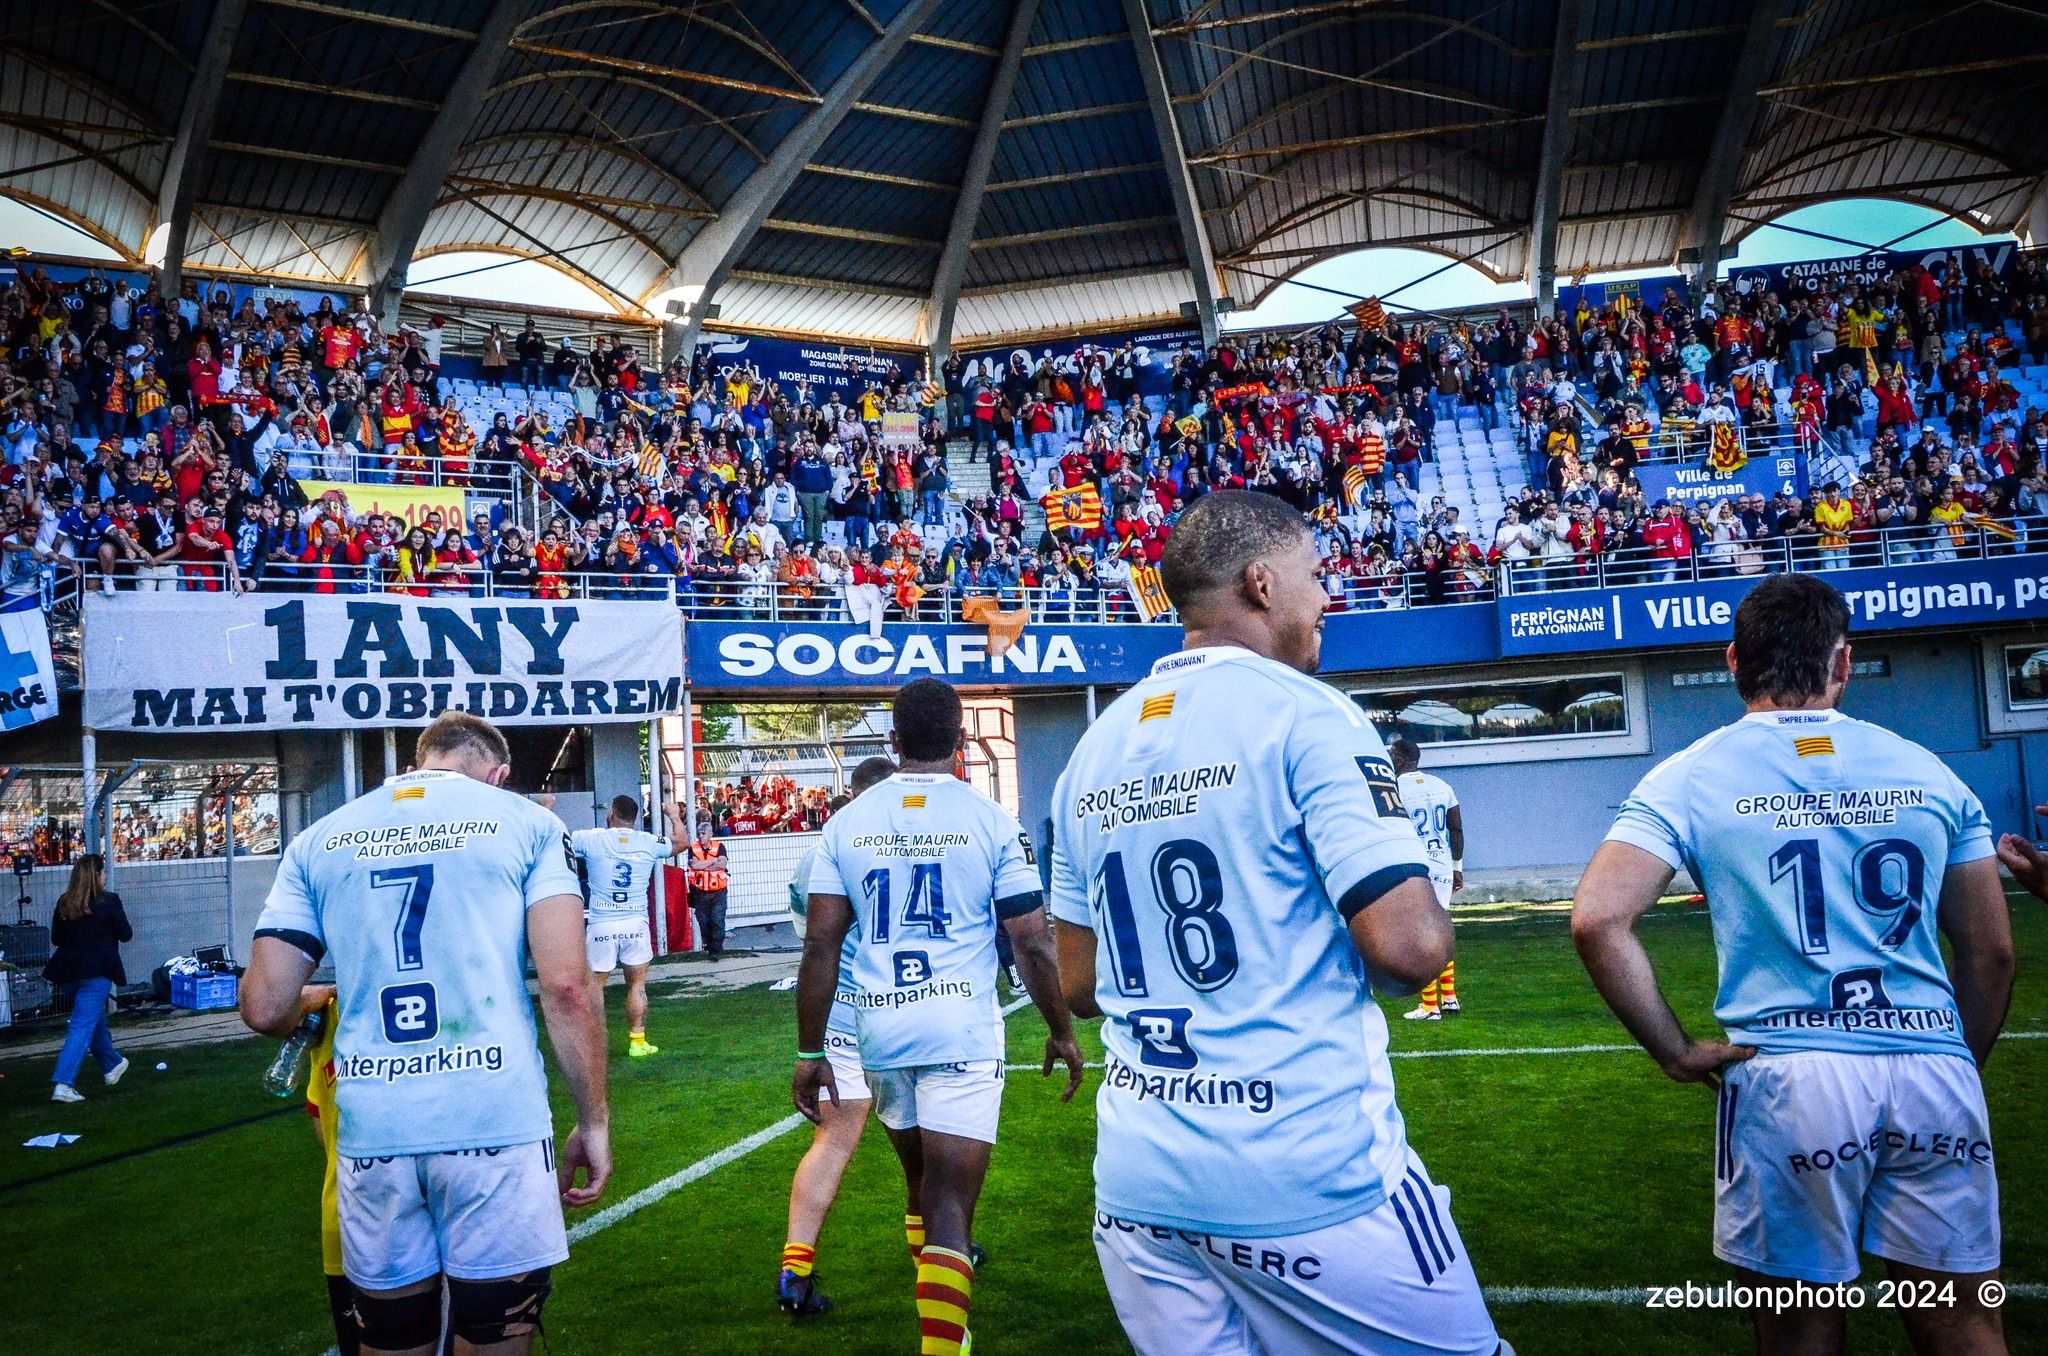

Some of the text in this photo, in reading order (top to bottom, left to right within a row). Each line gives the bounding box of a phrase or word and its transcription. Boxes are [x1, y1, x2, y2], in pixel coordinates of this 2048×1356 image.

[1782, 257, 1886, 278] CATALANE de
[257, 290, 291, 301] USAP
[1608, 282, 1637, 292] USAP
[801, 350, 841, 362] MAGASIN
[810, 360, 826, 368] ZONE
[1755, 363, 1766, 374] 15
[1218, 384, 1258, 398] USAP
[1676, 470, 1710, 483] Ville
[1666, 483, 1745, 501] Perpignan
[1783, 480, 1794, 495] 6
[1645, 596, 1731, 629] Ville
[1844, 582, 2005, 621] rpignan,
[264, 599, 580, 680] 1 ANY
[1511, 621, 1605, 637] LA RAYONNANTE
[719, 633, 1087, 677] SOCAFNA
[131, 676, 681, 727] MAI T'OBLIDAREM
[1778, 716, 1802, 724] SEMPRE
[1151, 764, 1237, 798] MAURIN
[1736, 789, 1923, 815] GROUPE MAURIN
[1412, 804, 1446, 838] 20
[1776, 809, 1894, 829] AUTOMOBILE
[325, 822, 498, 851] GROUPE MAURIN
[357, 836, 466, 858] AUTOMOBILE
[912, 834, 969, 846] MAURIN
[875, 847, 946, 858] AUTOMOBILE
[612, 862, 633, 888] 3
[861, 862, 952, 945] 14
[1769, 838, 1925, 956] 19
[370, 863, 434, 972] 7
[1093, 838, 1239, 998] 18
[1105, 1057, 1274, 1114] terparking
